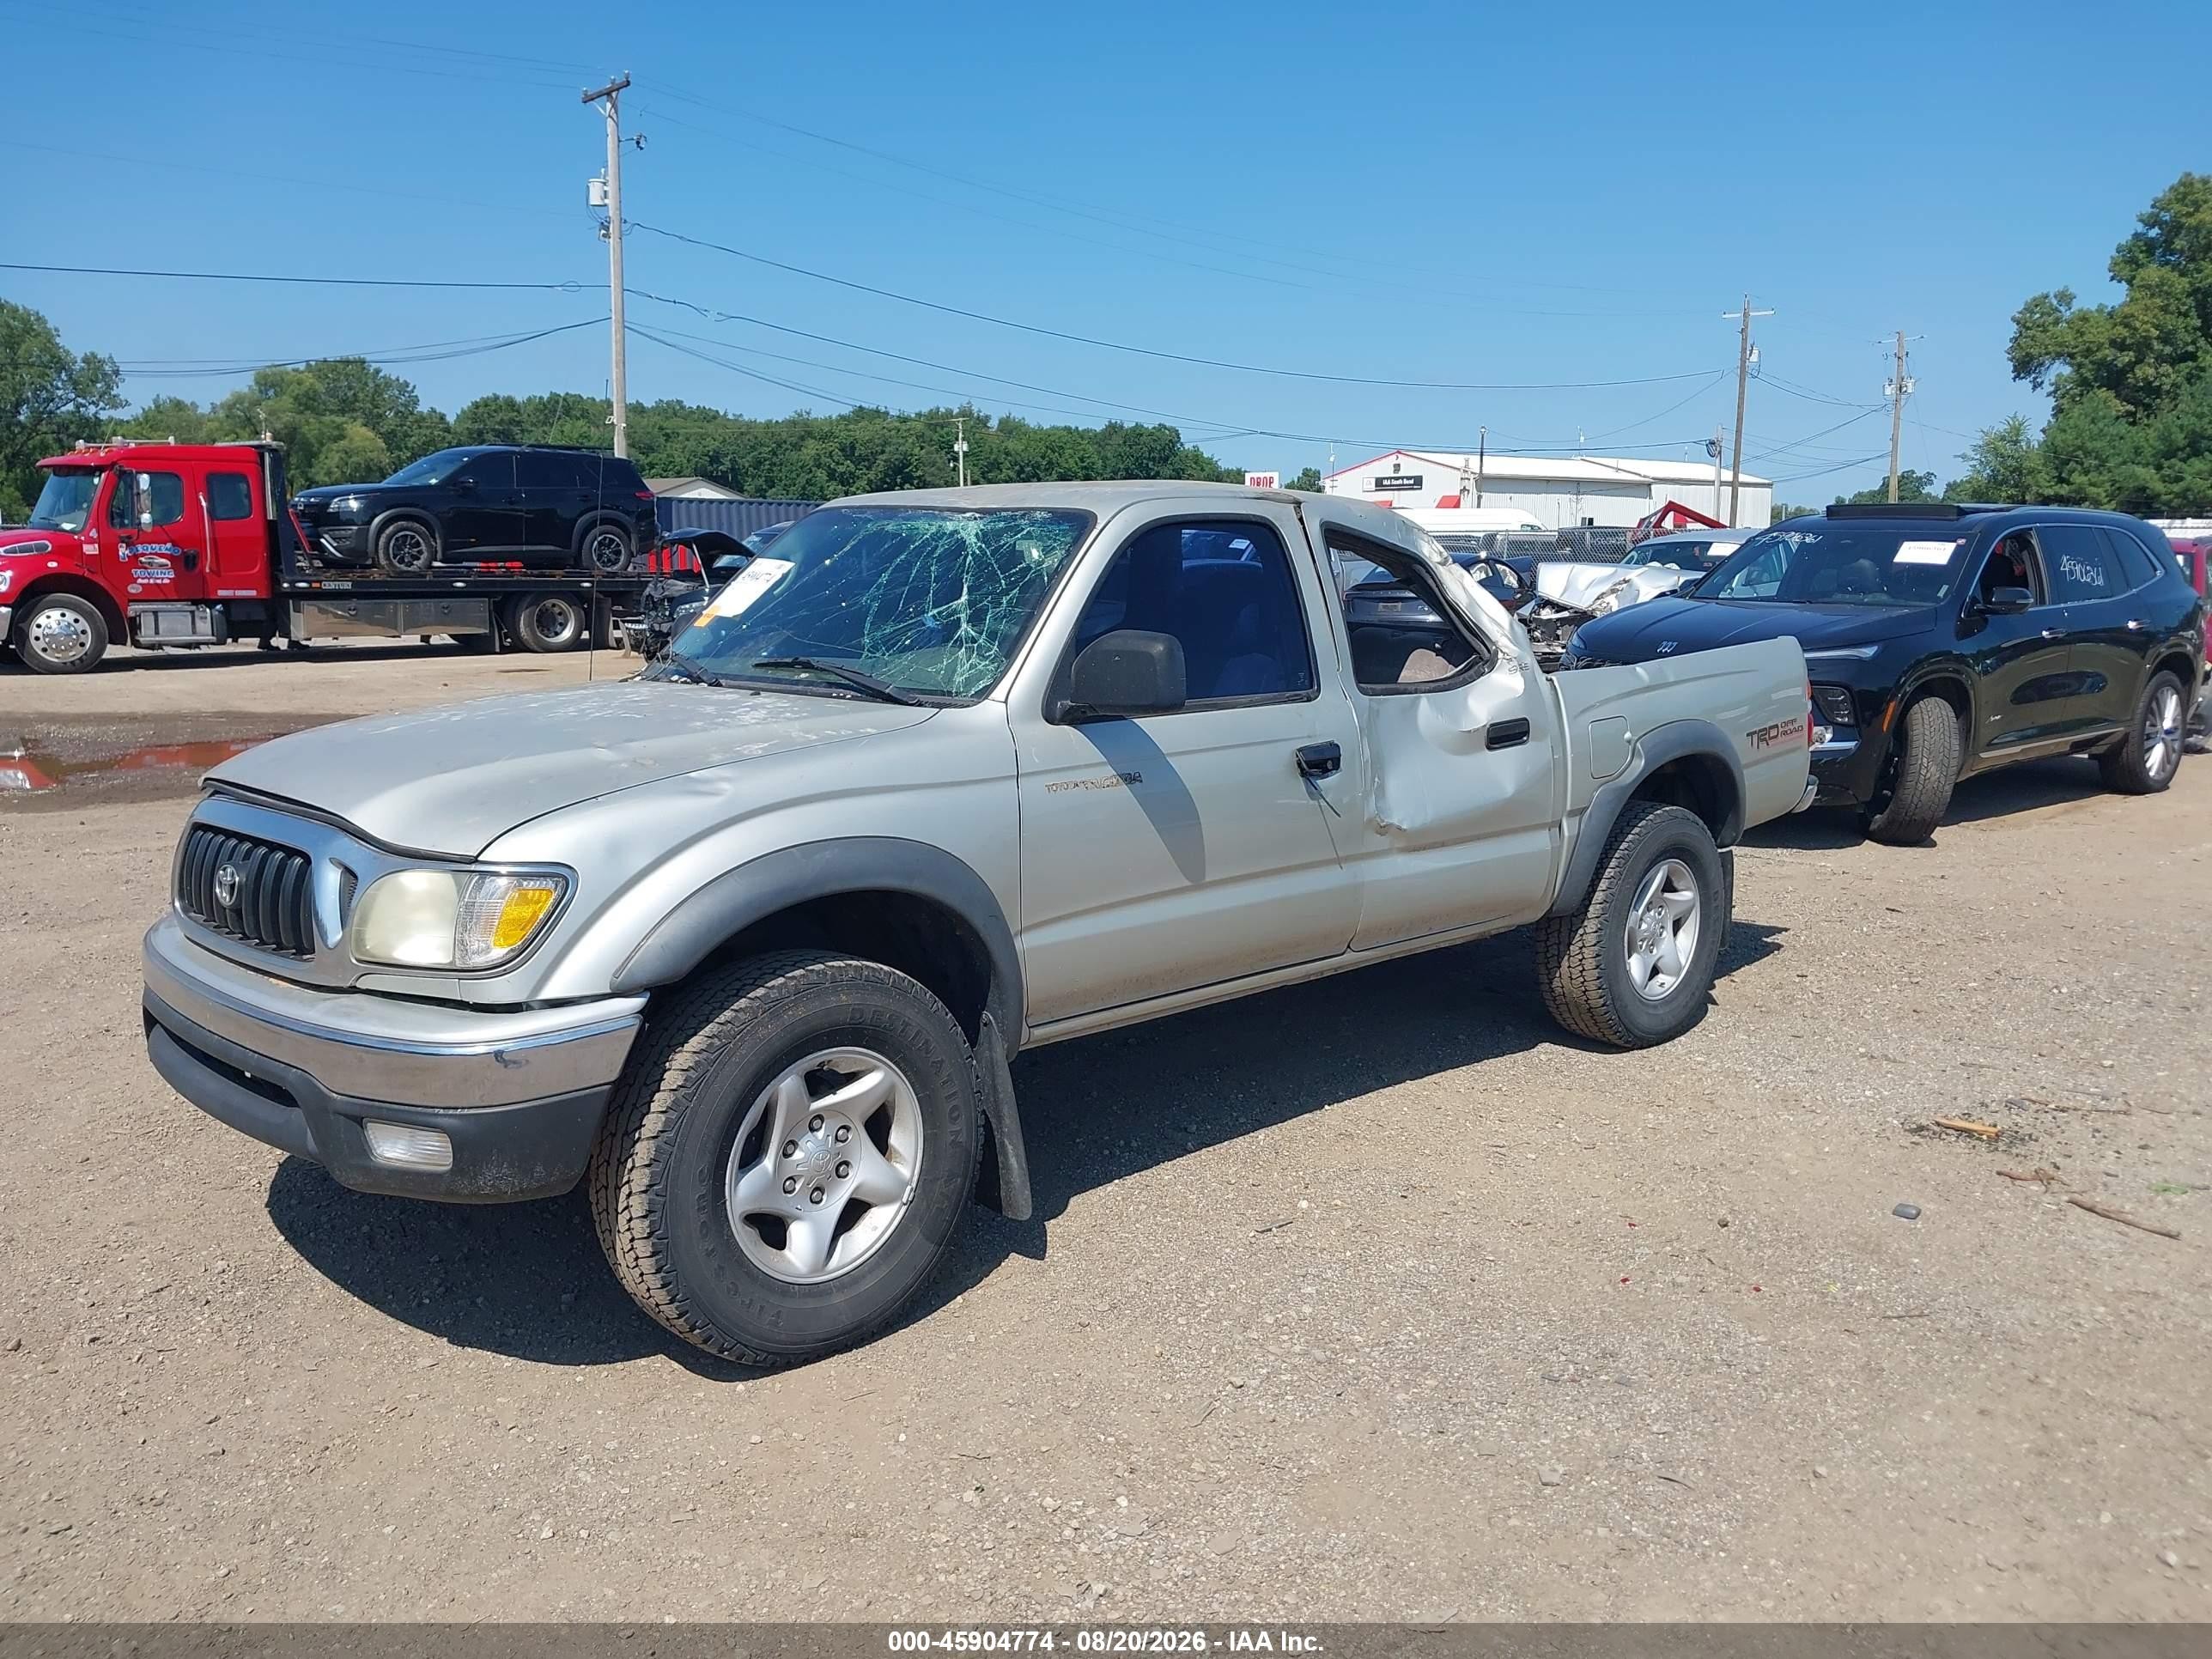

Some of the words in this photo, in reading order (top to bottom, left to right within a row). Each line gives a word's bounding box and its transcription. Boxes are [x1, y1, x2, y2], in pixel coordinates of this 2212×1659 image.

[1250, 477, 1274, 489] DROP
[131, 568, 174, 578] TOWING
[1780, 718, 1797, 728] OFF
[1746, 723, 1779, 750] TRD
[1780, 725, 1804, 738] ROAD
